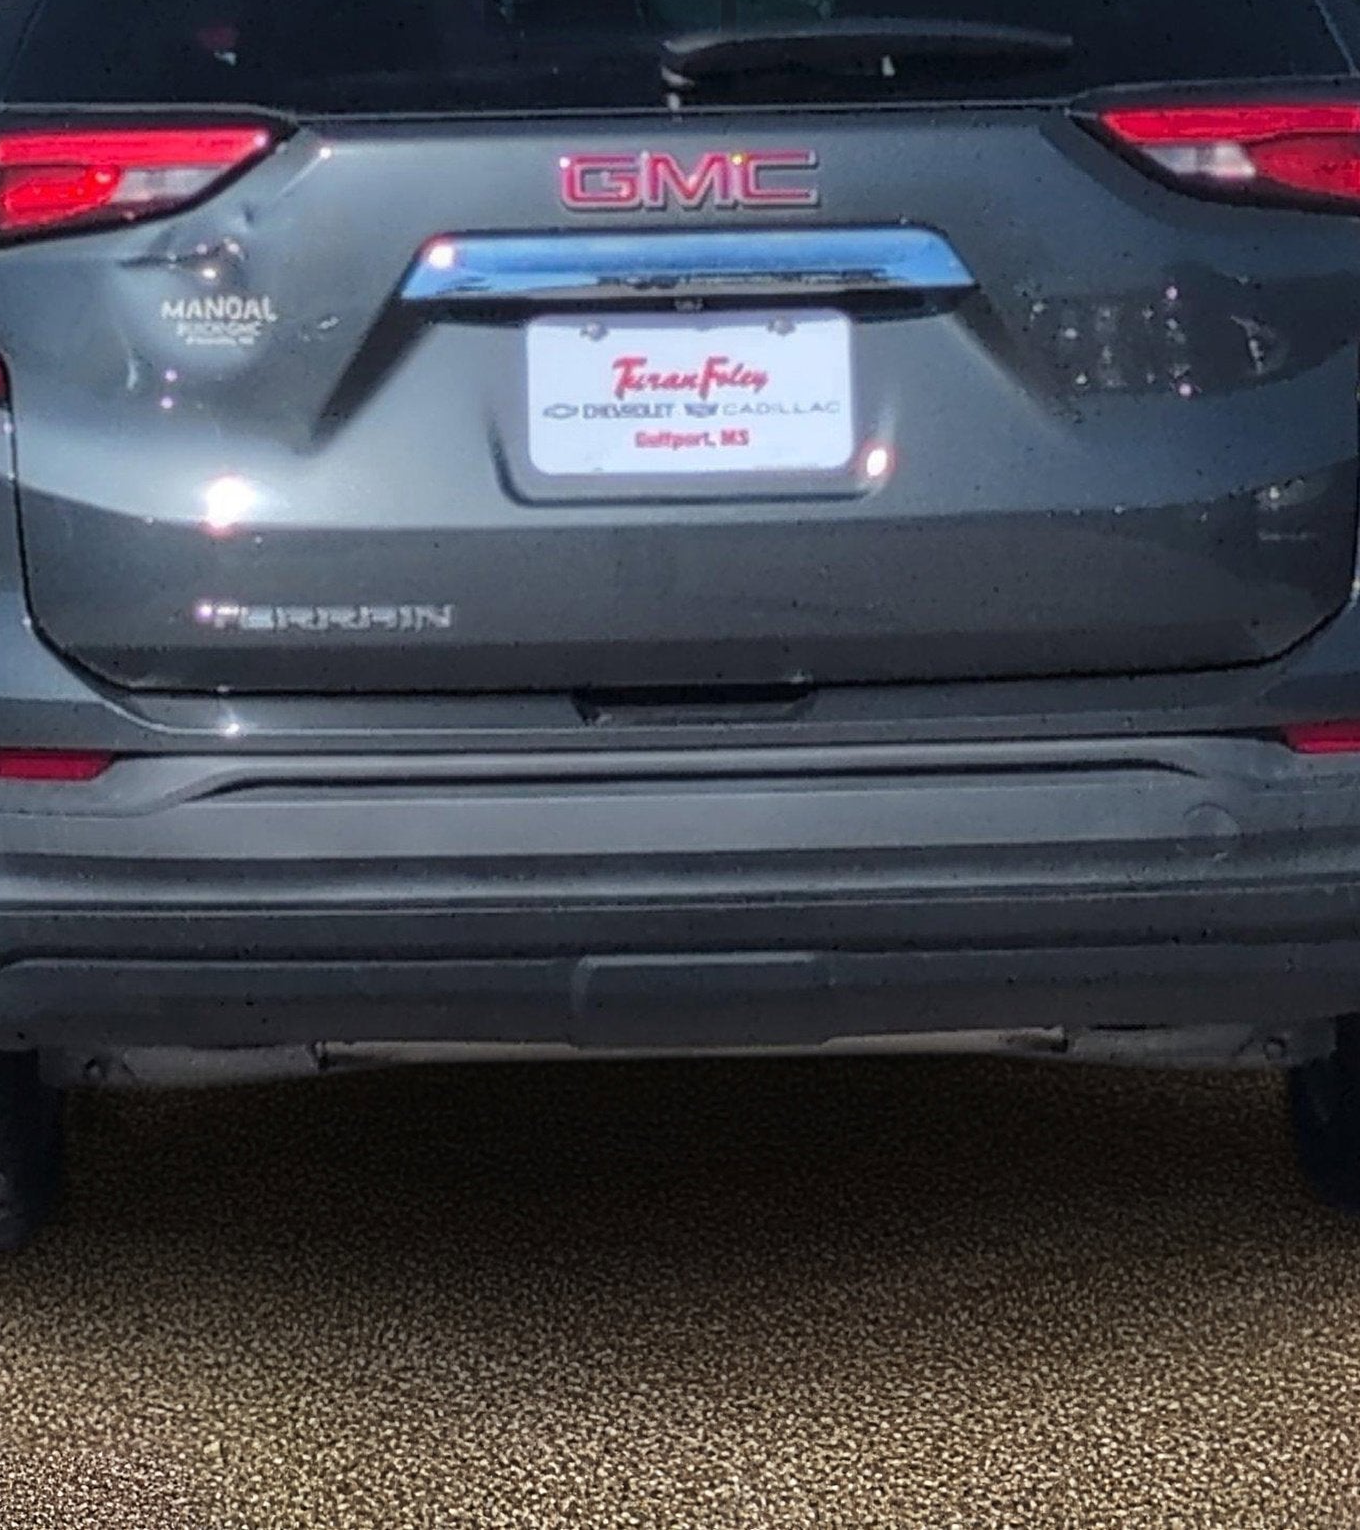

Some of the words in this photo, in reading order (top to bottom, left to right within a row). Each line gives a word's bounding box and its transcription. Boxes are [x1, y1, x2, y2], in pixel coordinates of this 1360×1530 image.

[559, 150, 818, 210] GMC
[612, 356, 698, 399] Turan
[699, 356, 769, 400] Foley
[723, 402, 840, 416] CADILLAC
